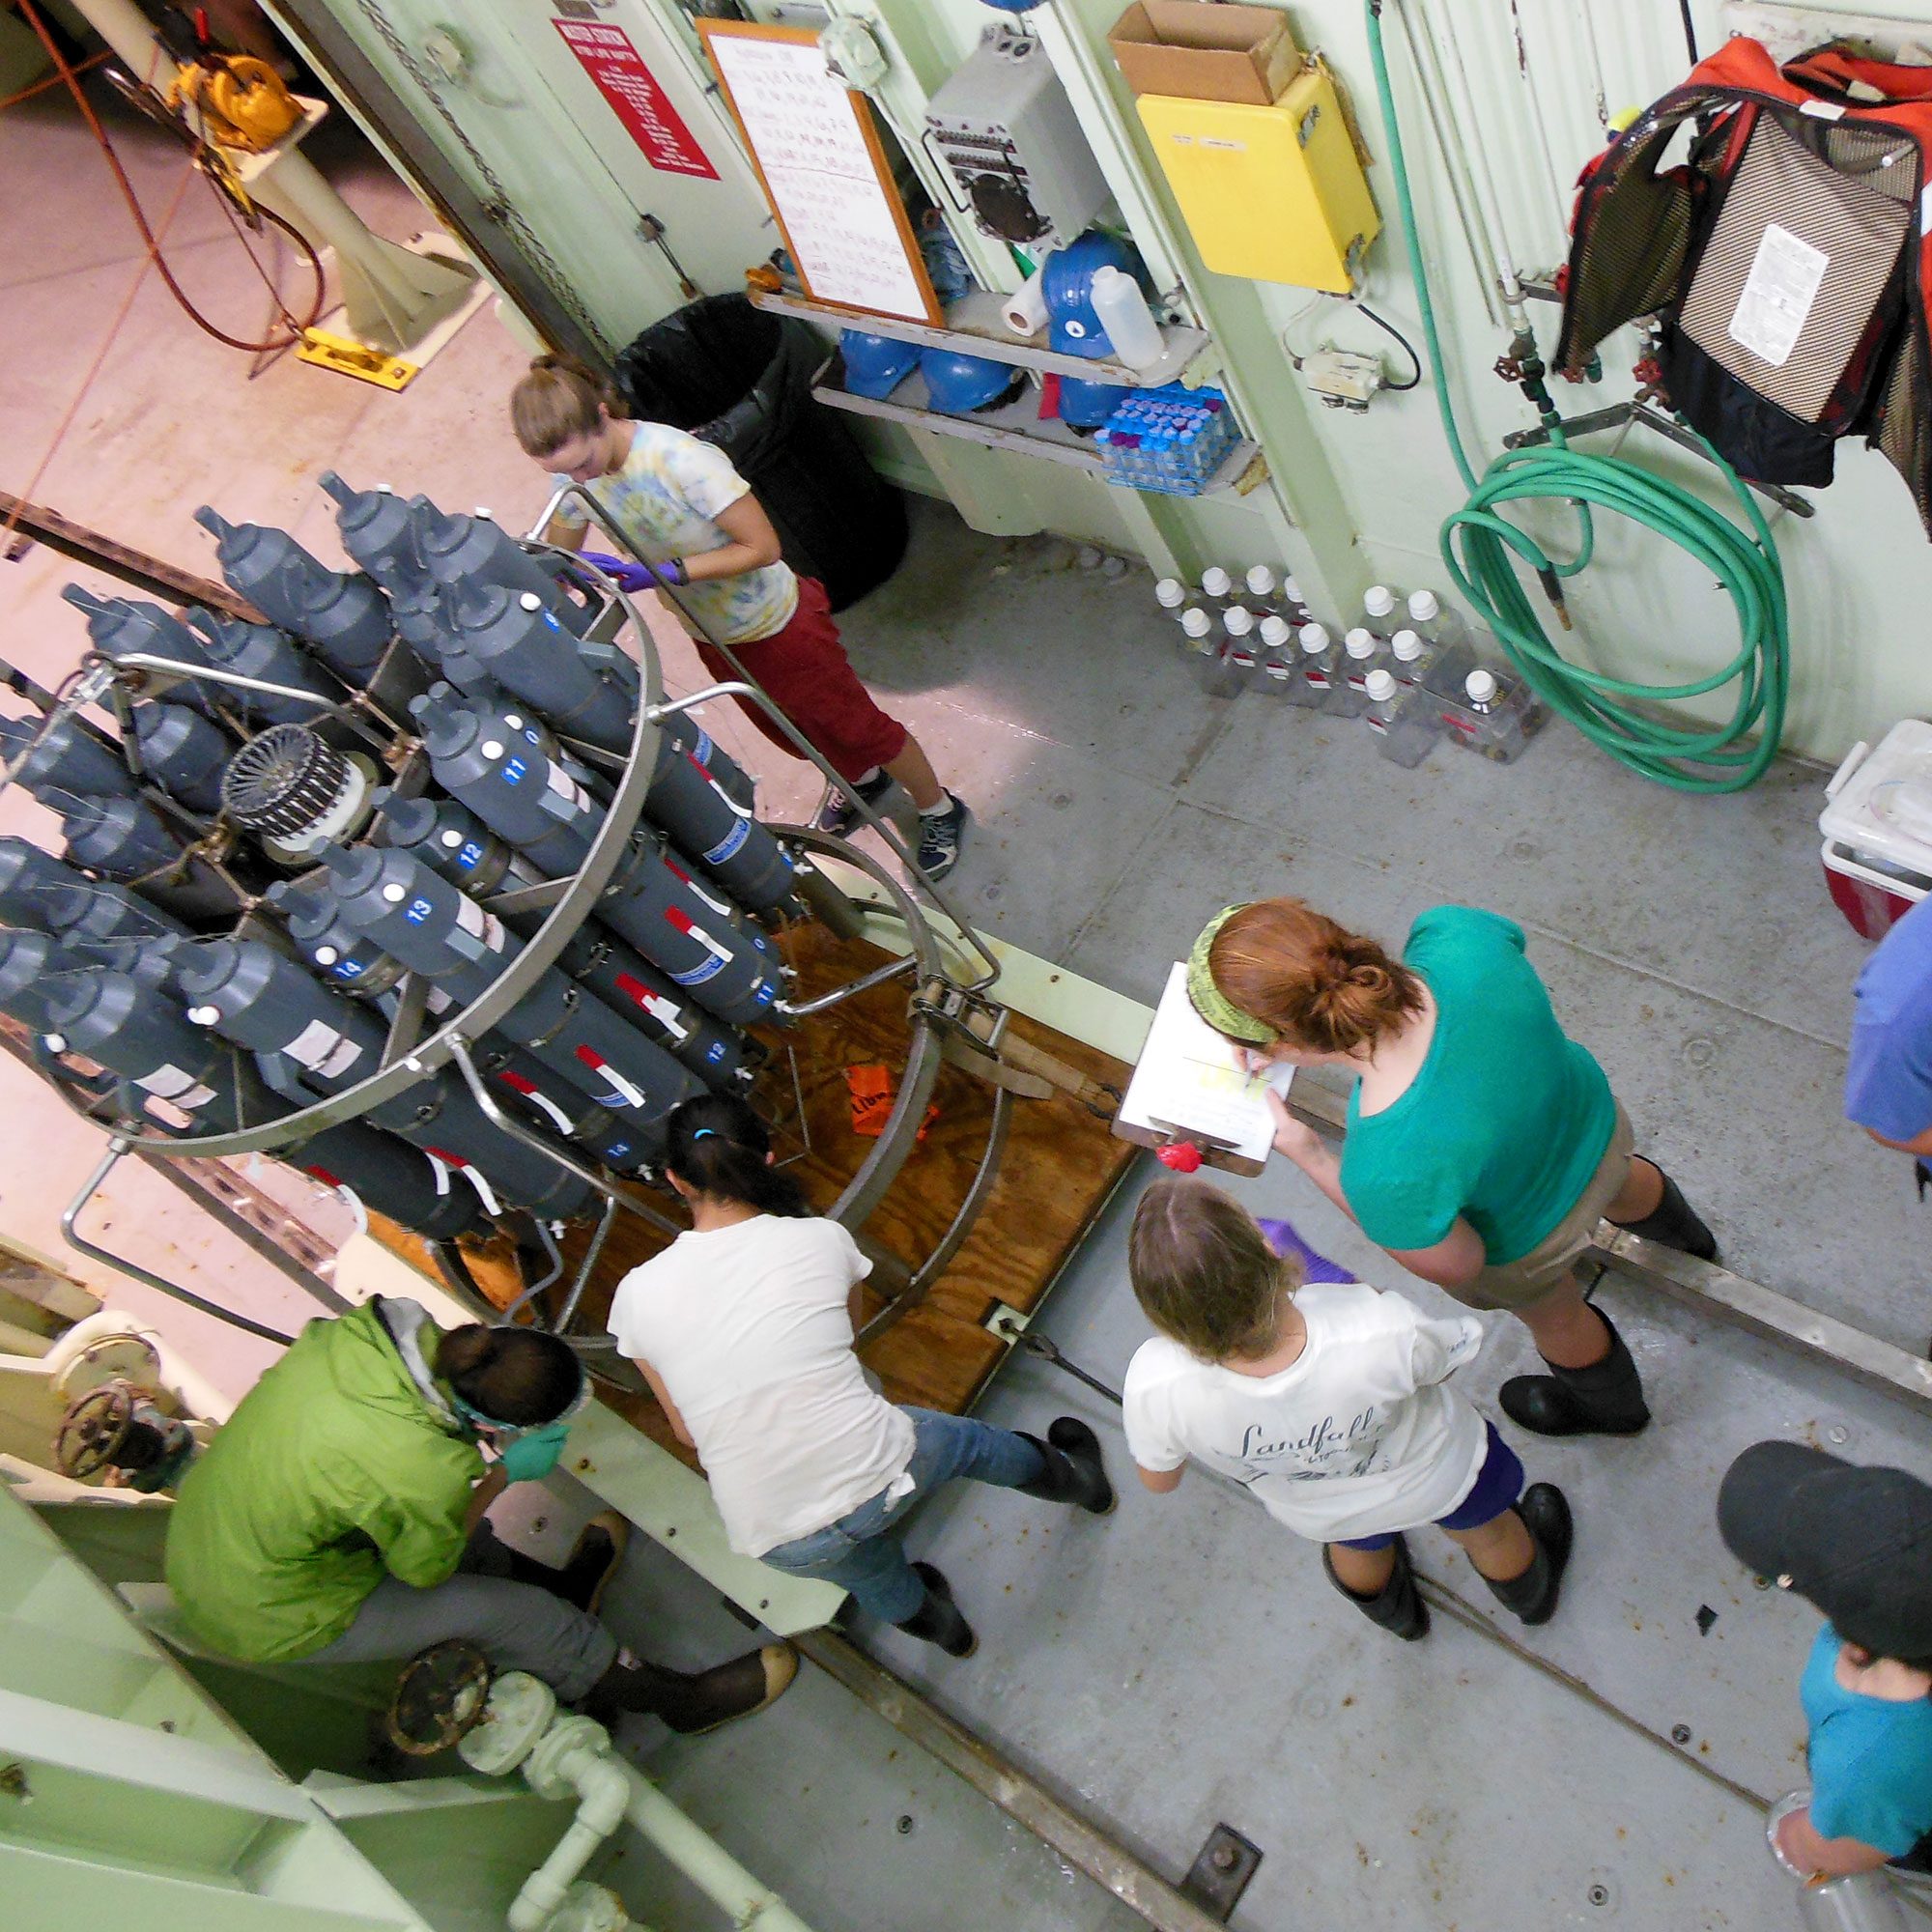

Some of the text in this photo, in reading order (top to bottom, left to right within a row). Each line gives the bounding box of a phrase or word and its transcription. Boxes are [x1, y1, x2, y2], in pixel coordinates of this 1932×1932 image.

[504, 758, 526, 780] 11
[460, 842, 483, 866] 12
[408, 899, 433, 922] 13
[335, 961, 362, 978] 14
[757, 984, 774, 1001] 11
[707, 1042, 726, 1061] 12
[607, 1143, 630, 1157] 14
[1240, 1406, 1375, 1459] Landfall
